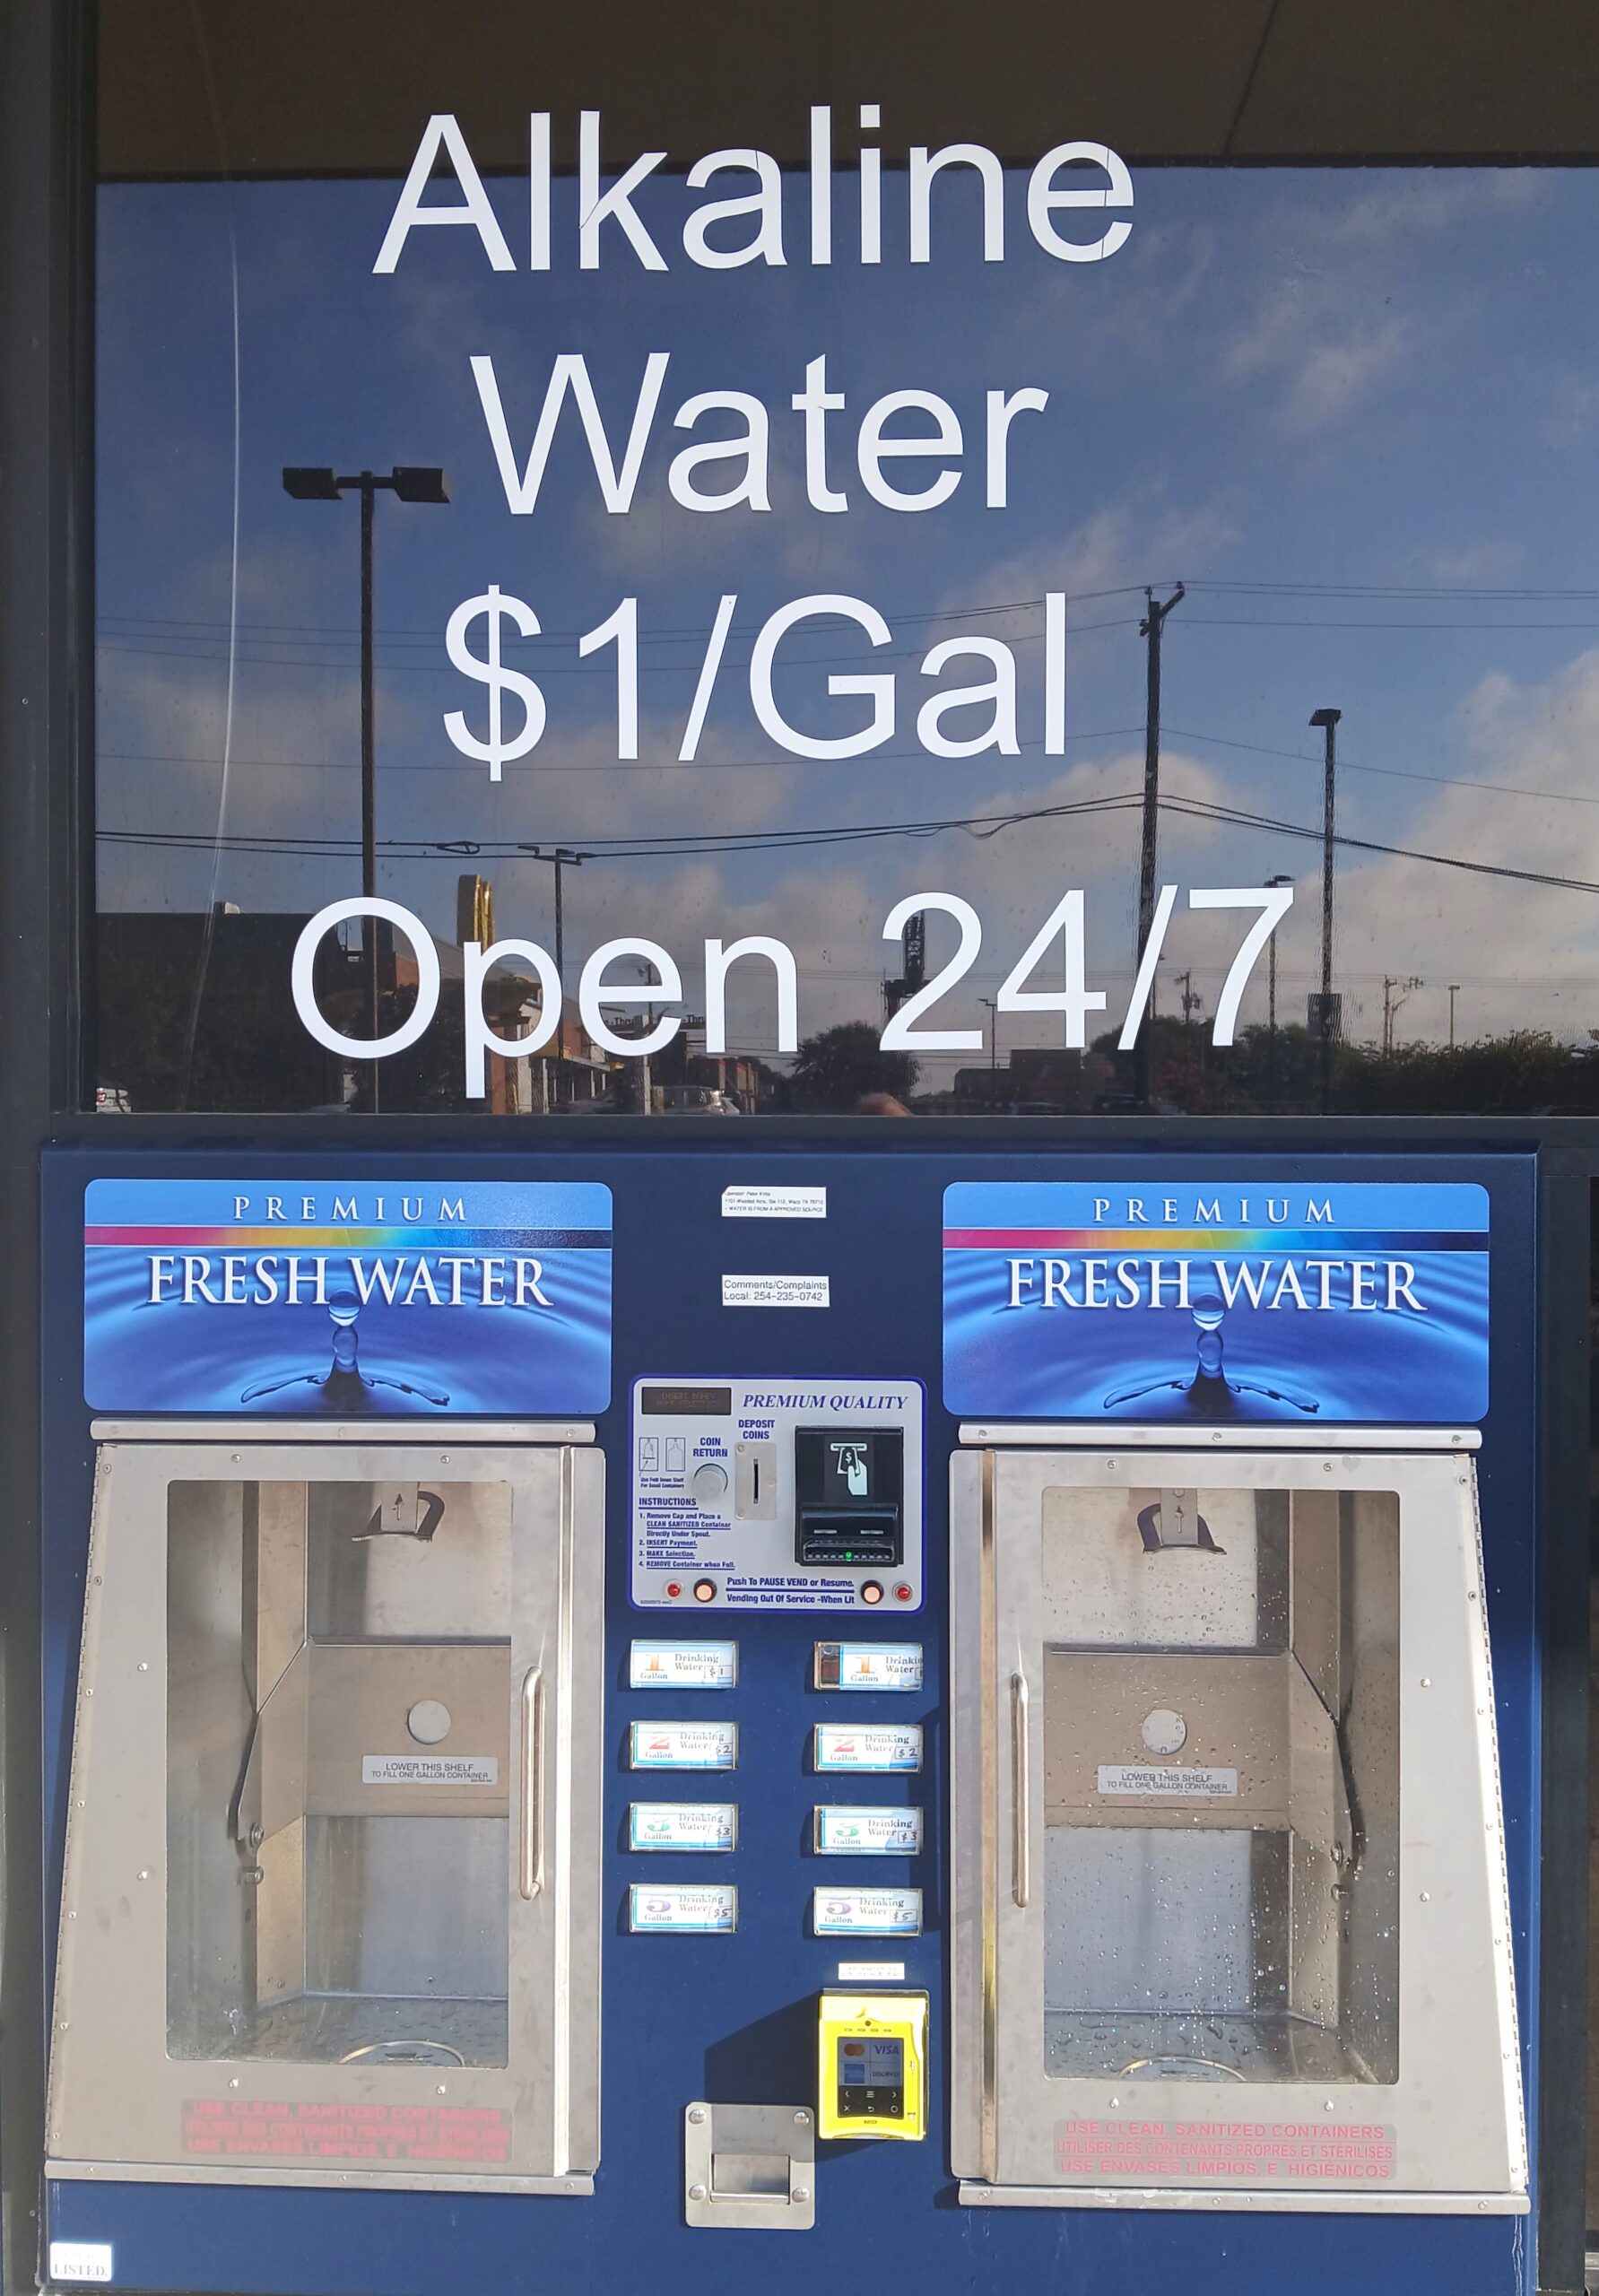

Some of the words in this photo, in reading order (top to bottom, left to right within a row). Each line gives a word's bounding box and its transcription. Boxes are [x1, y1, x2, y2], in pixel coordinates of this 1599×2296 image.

[371, 104, 1135, 274] Alkaline
[469, 352, 1050, 516] Water
[443, 584, 1065, 782] $1/Gal
[291, 896, 798, 1100] Open
[879, 884, 1295, 1052] 24/7
[233, 1196, 468, 1221] PREMIUM
[1093, 1198, 1335, 1222] PREMIUM
[146, 1255, 331, 1306] FRESH
[348, 1257, 554, 1307] WATER
[724, 1280, 827, 1290] Comments/Complaints
[1005, 1257, 1195, 1309] FRESH
[1212, 1260, 1428, 1311] WATER
[753, 1292, 822, 1300] 254-235-0742
[743, 1395, 826, 1408] PREMIUM
[830, 1396, 908, 1411] QUALITY
[738, 1420, 775, 1429] DEPOSIT
[743, 1431, 769, 1439] COINS
[700, 1438, 721, 1446] COIN
[693, 1448, 728, 1457] RETURN
[639, 1497, 697, 1506] INSTRUCTIONS
[727, 1578, 747, 1586] Push
[749, 1578, 757, 1586] To
[760, 1578, 785, 1586] PAUSE
[786, 1578, 808, 1587] VEND
[727, 1595, 758, 1604] Vending
[760, 1595, 774, 1603] Out
[776, 1595, 785, 1603] Of
[786, 1595, 815, 1603] Service
[845, 1596, 855, 1604] Lit
[674, 1654, 718, 1663] Drinking
[674, 1662, 703, 1671] Water
[885, 1665, 914, 1673] Water
[680, 1732, 725, 1742] Drinking
[865, 1735, 909, 1744] Drinking
[680, 1741, 708, 1749] Water
[421, 1763, 442, 1771] THIS
[444, 1763, 474, 1771] SHELF
[1122, 1773, 1155, 1781] LOWER
[1159, 1773, 1179, 1781] THIS
[1182, 1774, 1212, 1782] SHELF
[1185, 1782, 1228, 1790] CONTAINER
[679, 1813, 724, 1823] Drinking
[679, 1822, 708, 1831] Water
[868, 1820, 913, 1828] Drinking
[868, 1828, 897, 1836] Water
[679, 1894, 724, 1904] Drinking
[859, 1897, 905, 1908] Drinking
[859, 1907, 888, 1915] Water
[874, 2045, 899, 2055] VISA
[1065, 2121, 1099, 2134] USE
[1175, 2123, 1265, 2136] SANITIZED
[1271, 2124, 1384, 2139] CONTAINERS
[1057, 2140, 1113, 2153] UTILISER
[1117, 2142, 1142, 2154] DES
[1146, 2142, 1232, 2156] CONTENANTS
[1237, 2144, 1297, 2157] PROPRES
[1301, 2144, 1317, 2157] ET
[1061, 2158, 1094, 2172] USE
[1100, 2160, 1180, 2173] ENVASES
[1267, 2162, 1278, 2175] E
